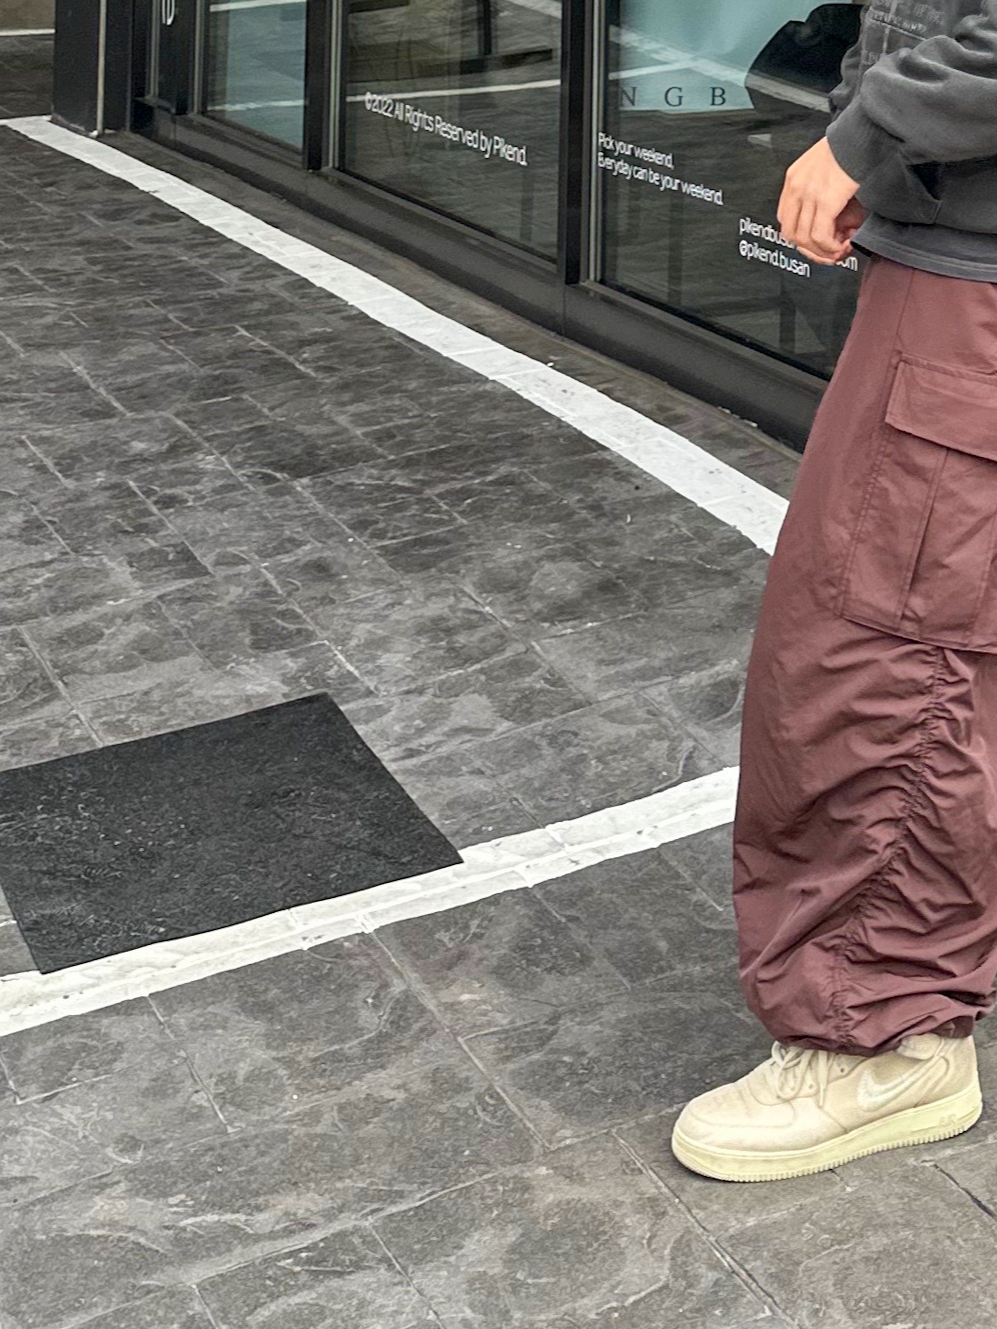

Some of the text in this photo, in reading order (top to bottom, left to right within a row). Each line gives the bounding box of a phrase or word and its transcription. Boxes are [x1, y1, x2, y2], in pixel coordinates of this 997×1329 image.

[365, 91, 528, 166] ©2022 All Rights Reserved by Pikend.
[598, 132, 615, 150] Pick
[614, 140, 634, 156] your
[597, 151, 632, 180] Everyday
[632, 165, 648, 181] can
[648, 168, 660, 185] be
[659, 174, 681, 191] your
